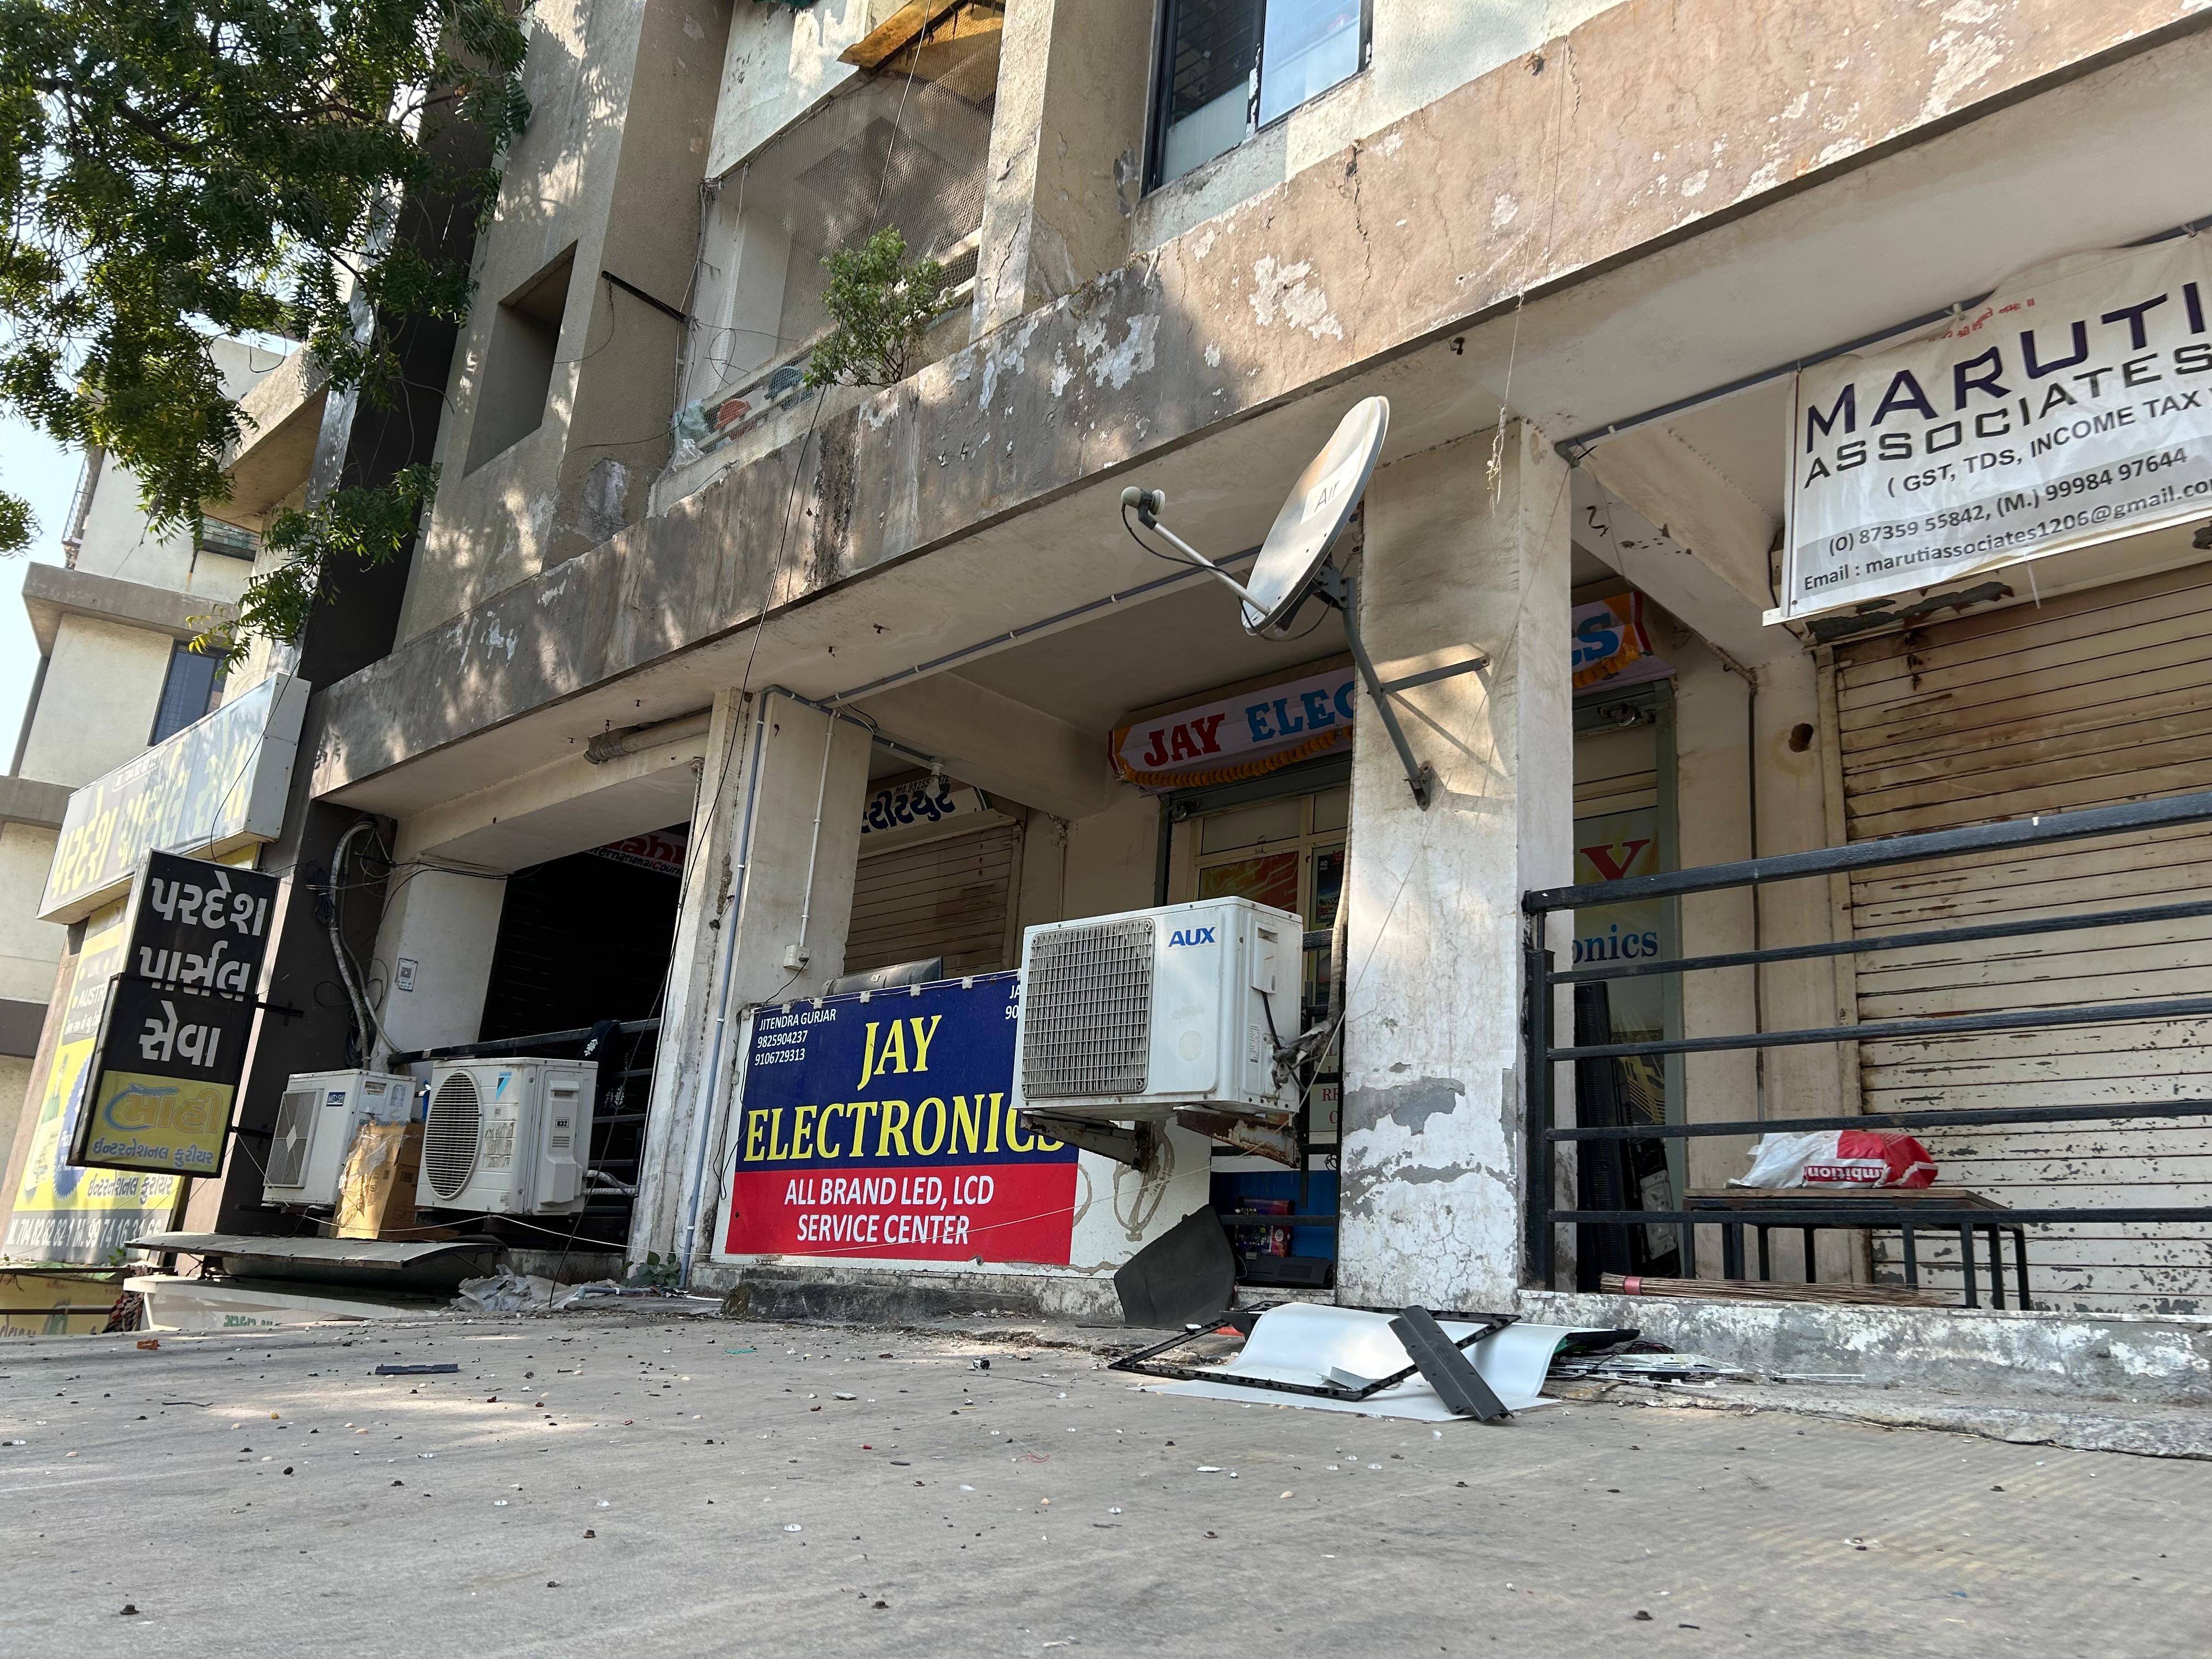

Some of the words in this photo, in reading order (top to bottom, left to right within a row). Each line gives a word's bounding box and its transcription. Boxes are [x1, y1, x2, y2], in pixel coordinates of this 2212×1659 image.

[1806, 281, 2207, 454] MARUTI
[1804, 343, 2212, 489] ASSOCIATES
[1962, 449, 2023, 475] TDS,
[2030, 405, 2136, 458] INCOME
[2142, 390, 2202, 419] TAX
[1859, 521, 1918, 545] 87359
[1925, 505, 1992, 538] 55842,
[1996, 489, 2041, 518] (M.)
[2045, 469, 2113, 503] 99984
[2118, 447, 2189, 481] 97644
[1804, 563, 1849, 591] Email
[1865, 478, 2212, 575] marutiassociates1206@gmail.co
[1144, 713, 1225, 767] JAY
[52, 785, 119, 899] પરદેશ
[151, 870, 268, 936] પરદેશ
[1167, 926, 1217, 948] AUX
[139, 940, 251, 1002] પાર્સલ
[139, 1000, 221, 1068] સેવા
[757, 1030, 808, 1048] 9825904237
[759, 1011, 799, 1031] JITENDRA
[800, 1008, 837, 1026] GURJAR
[754, 1048, 805, 1066] 9106729313
[857, 1014, 942, 1091] JAY
[120, 1084, 224, 1135] માહી
[93, 1137, 170, 1160] ઈન્ટરનેશનલ
[174, 1143, 214, 1168] કુરીયર
[1808, 1167, 1882, 1181] mbition
[784, 1177, 816, 1206] ALL
[820, 1176, 896, 1206] BRAND
[900, 1175, 948, 1211] LED,
[953, 1175, 995, 1206] LCD
[797, 1214, 879, 1243] SERVICE
[883, 1214, 970, 1245] CENTER
